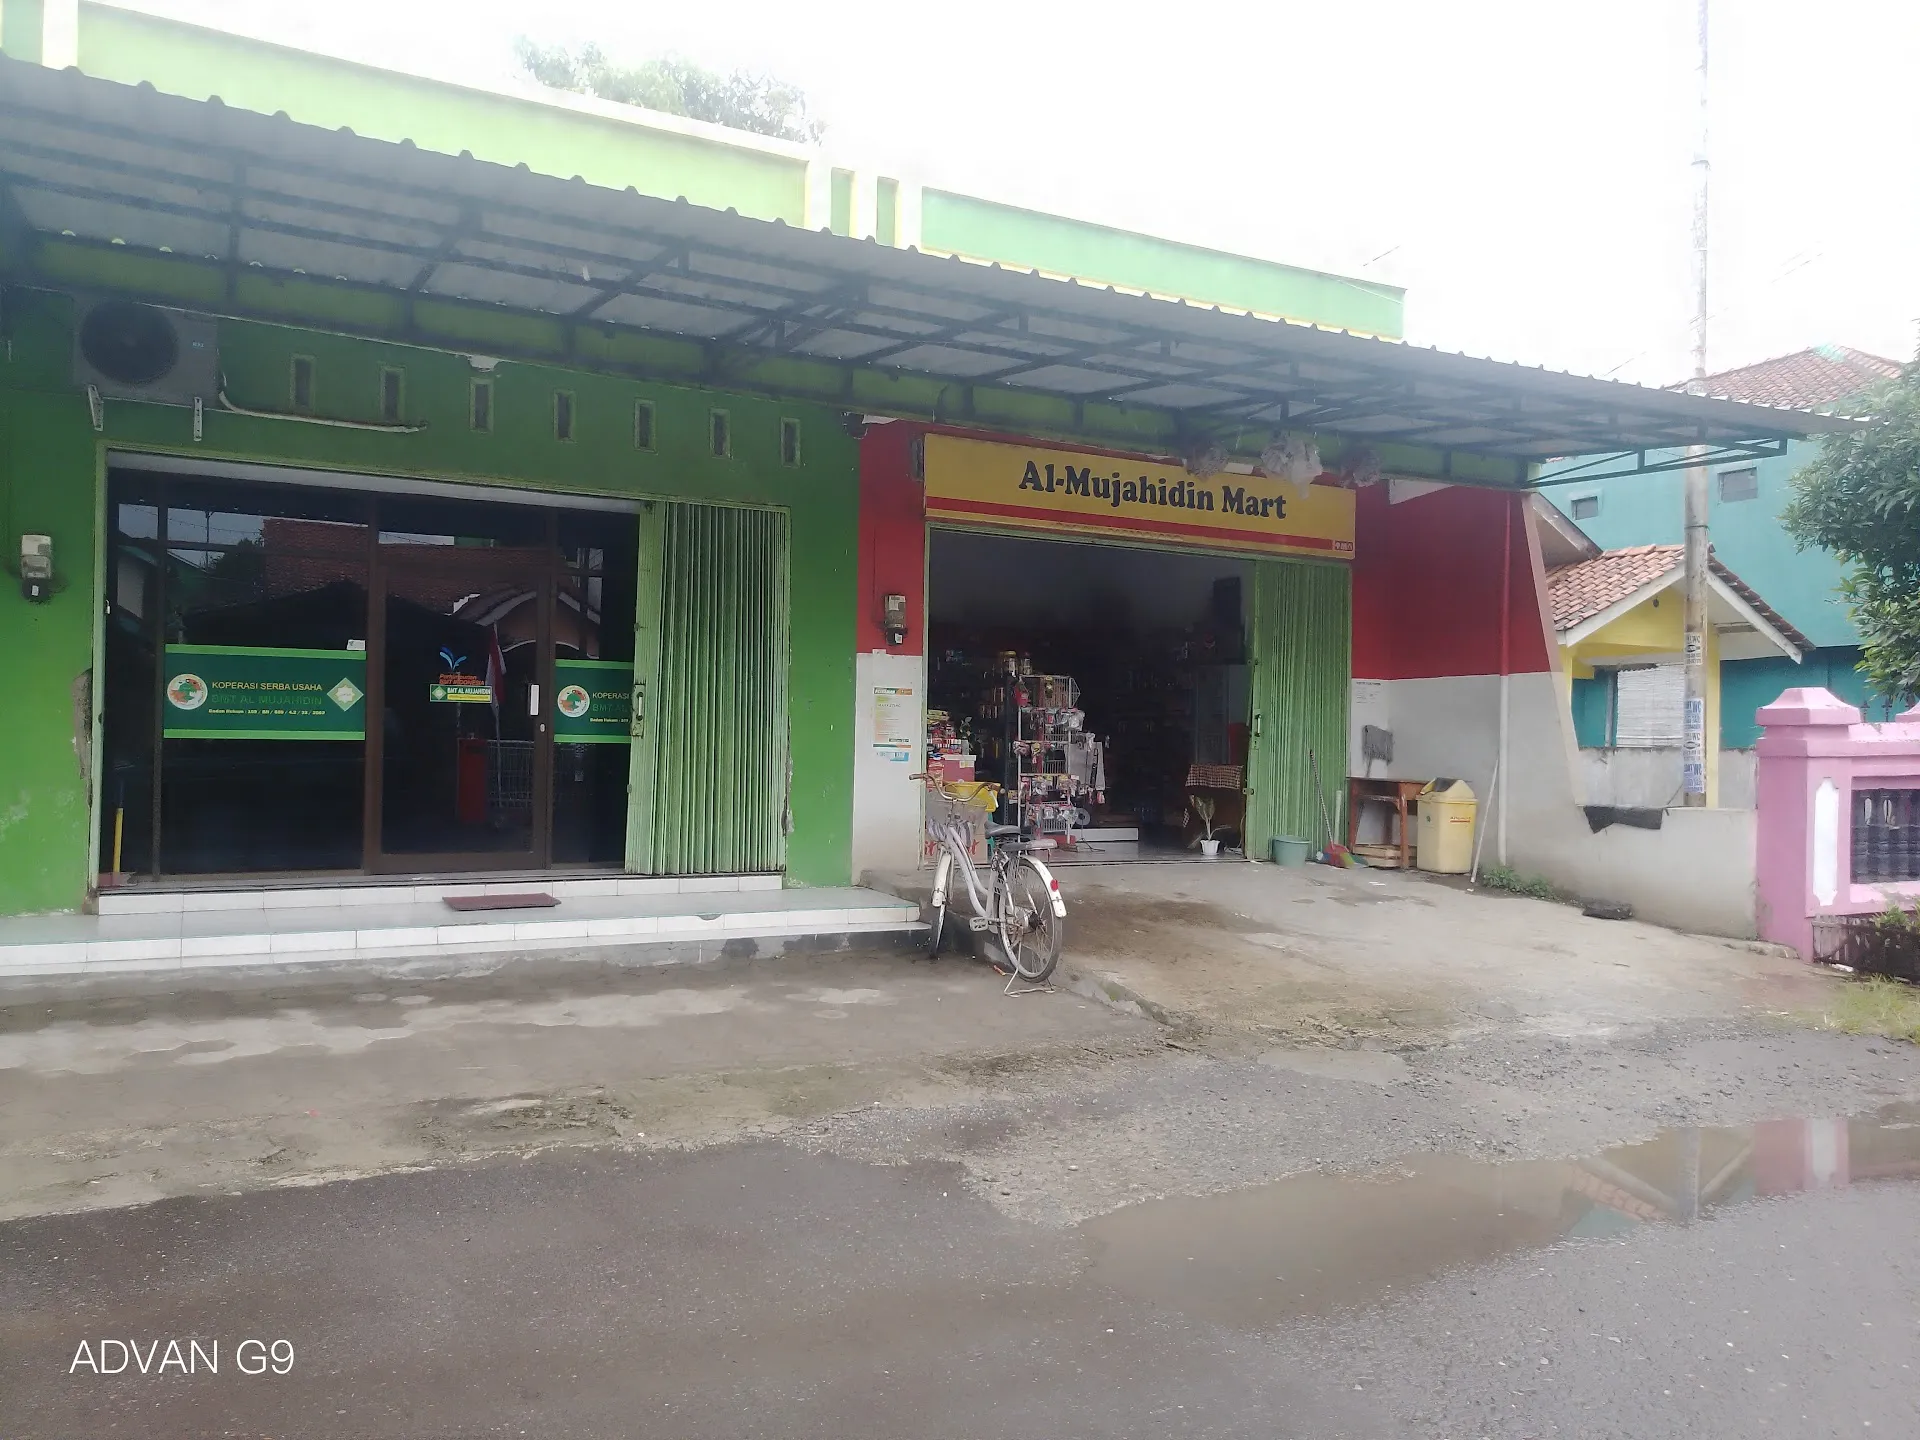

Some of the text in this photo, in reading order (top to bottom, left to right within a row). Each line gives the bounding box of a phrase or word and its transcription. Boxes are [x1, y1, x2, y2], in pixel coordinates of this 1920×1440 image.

[1018, 460, 1287, 519] Al-Mujahidin Mart
[212, 681, 323, 691] KOPERASI SERBA USAHA
[212, 693, 322, 705] BMT AL MUJAHIDIN
[592, 692, 630, 700] KOPERASI
[592, 703, 613, 712] BMT
